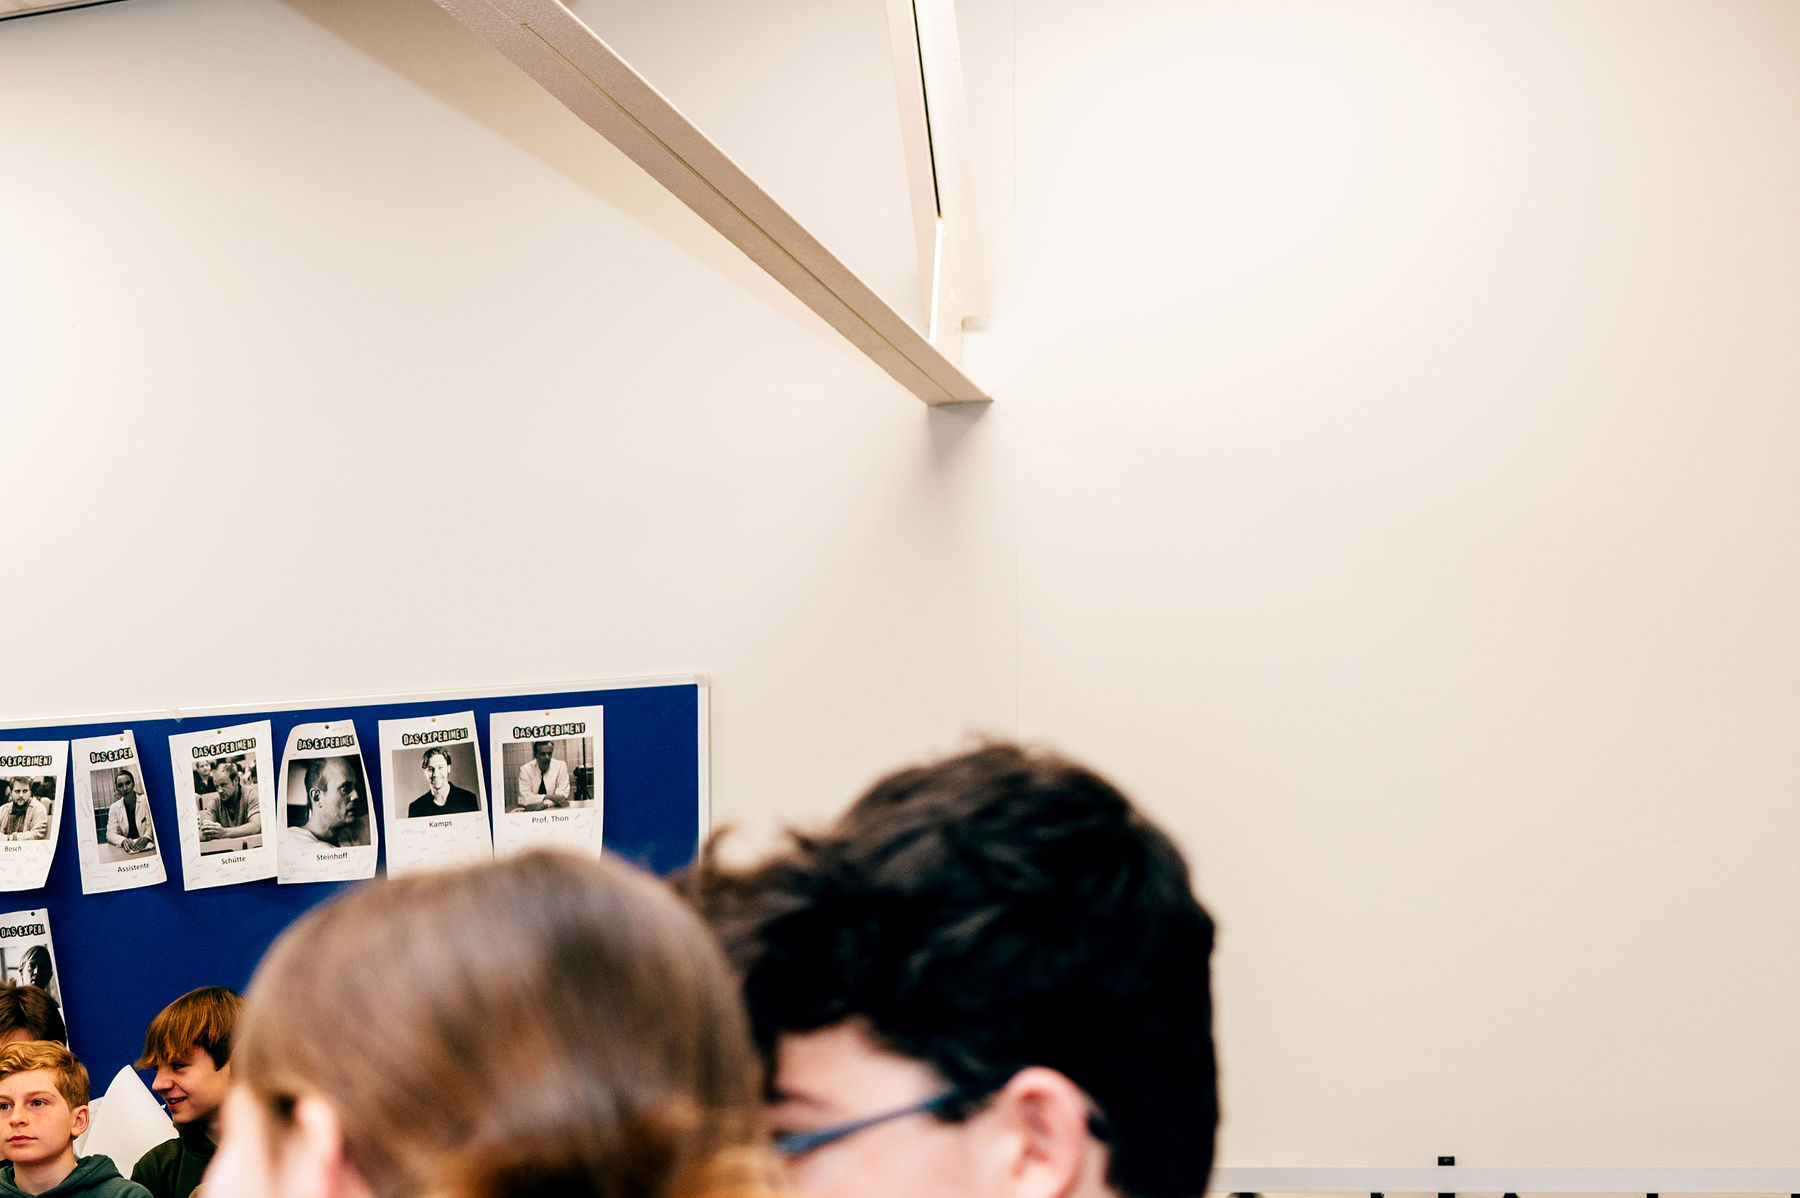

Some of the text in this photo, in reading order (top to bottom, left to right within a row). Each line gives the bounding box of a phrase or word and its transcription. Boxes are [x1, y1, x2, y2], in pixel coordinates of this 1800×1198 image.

[513, 722, 586, 740] DAS EXPERIMENT
[297, 738, 313, 751] DAS
[402, 732, 420, 746] DAS
[191, 737, 257, 758] DAS EXPERIMENT
[6, 755, 52, 767] EXPERIMENT
[89, 751, 106, 764] DAS
[531, 815, 569, 824] Prof. Thon
[316, 851, 348, 861] Steinhoff
[117, 862, 150, 873] Assistente
[0, 926, 17, 938] DAS
